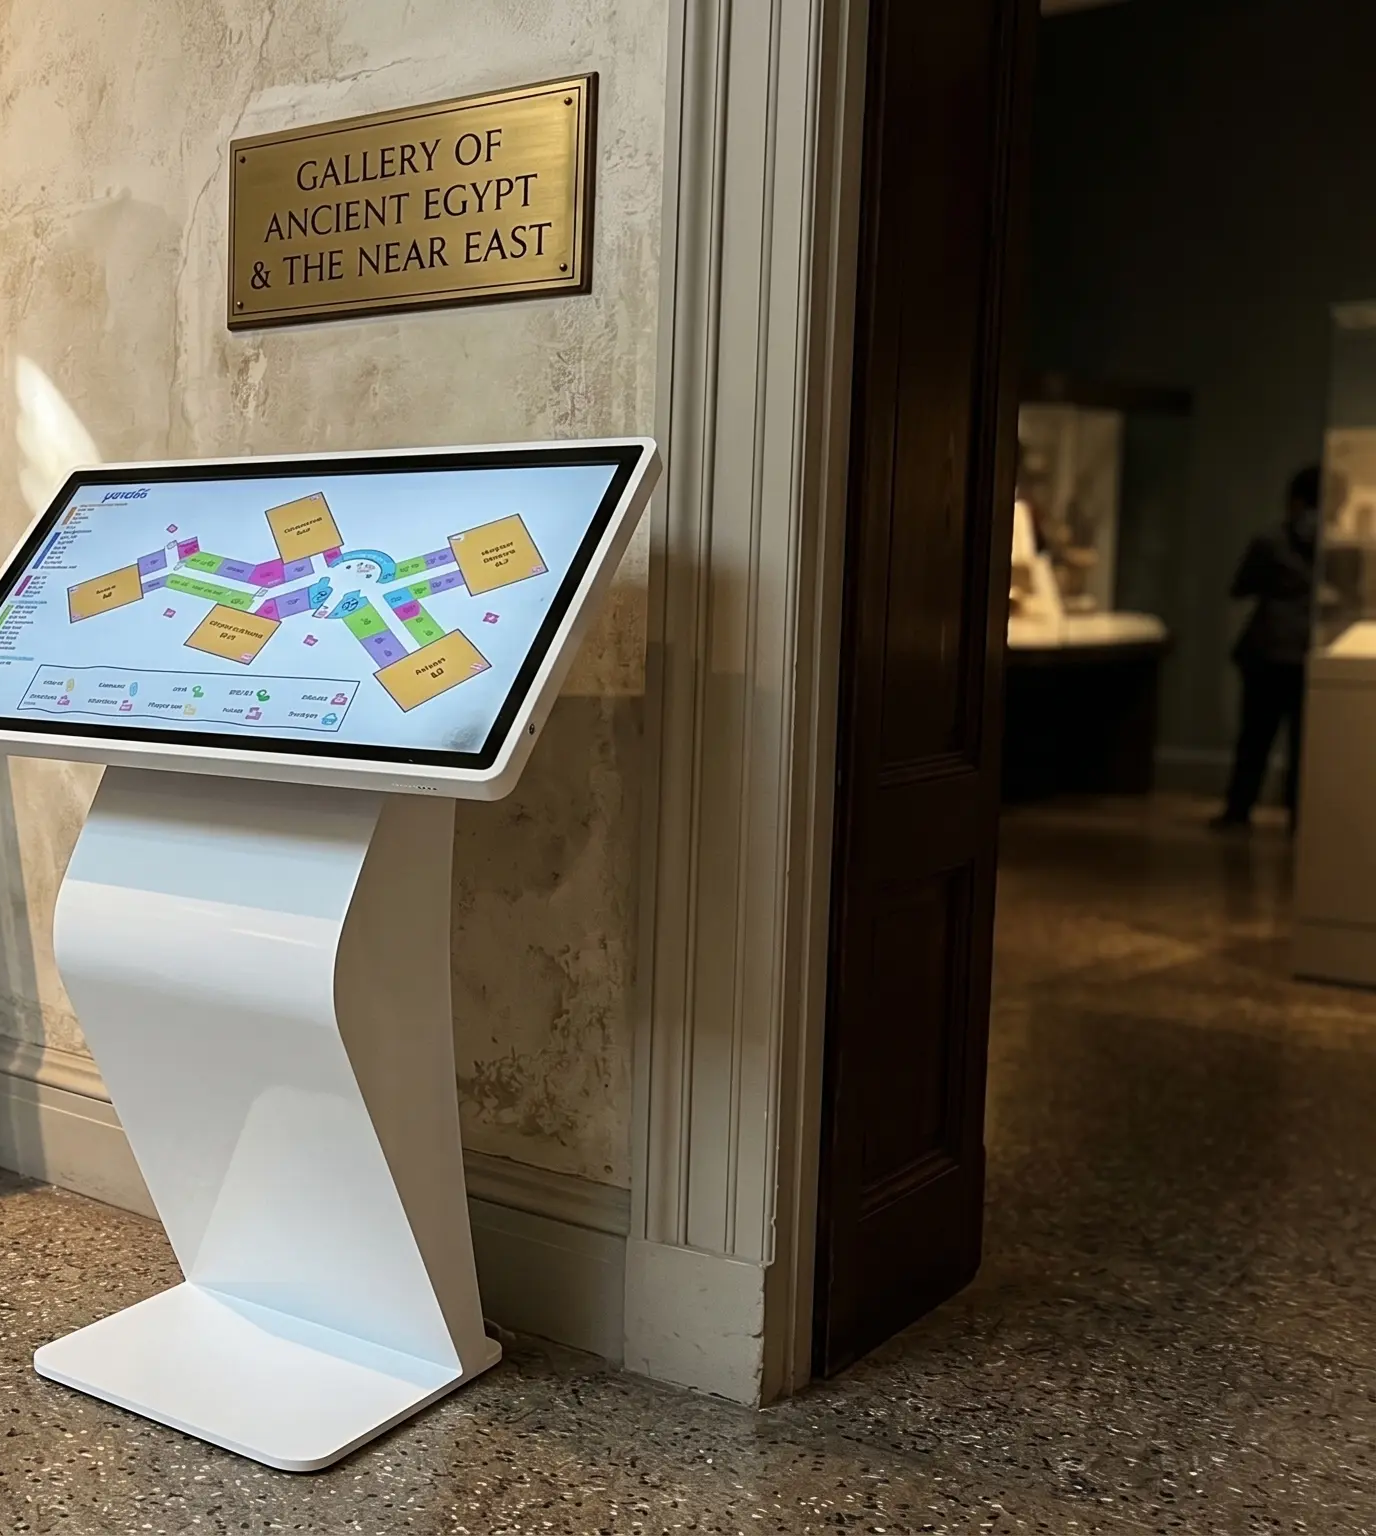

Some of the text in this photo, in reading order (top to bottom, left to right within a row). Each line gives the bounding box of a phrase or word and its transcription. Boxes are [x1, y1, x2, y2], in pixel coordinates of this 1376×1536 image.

[297, 129, 502, 191] GALLERY OF
[264, 173, 537, 242] ANCIENT EGYPT
[251, 222, 552, 289] & THE NEAR EAST
